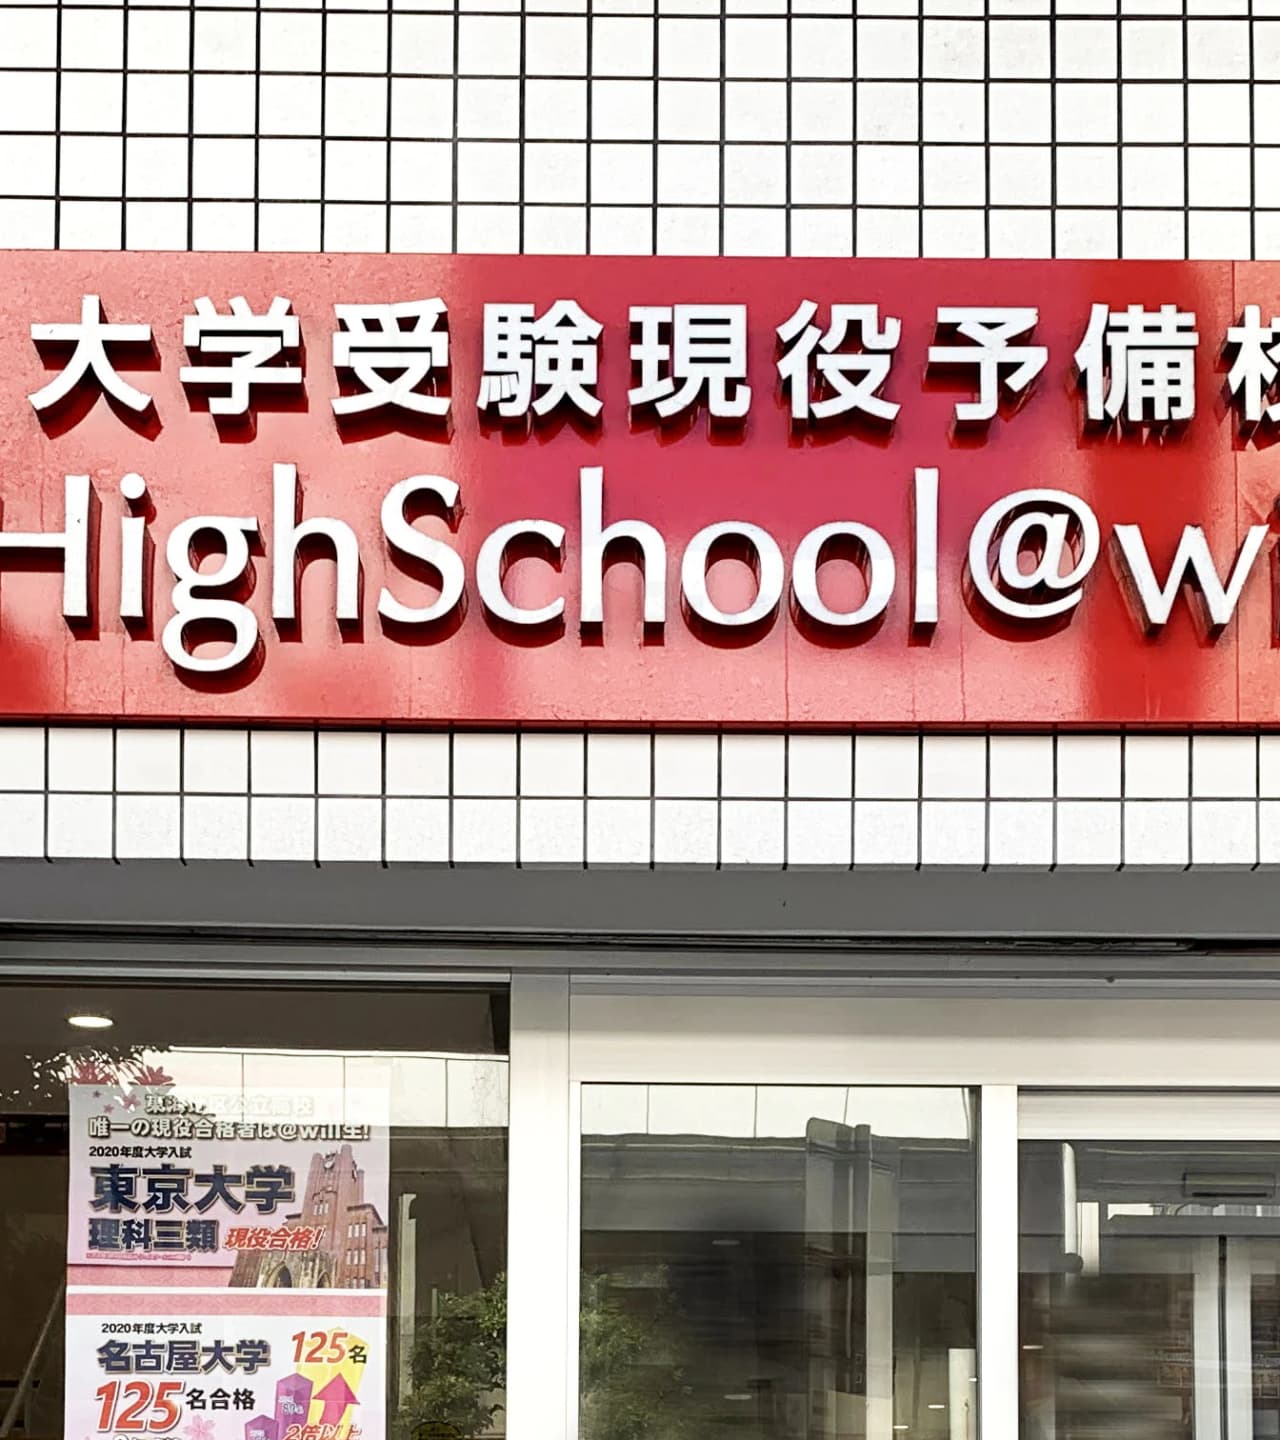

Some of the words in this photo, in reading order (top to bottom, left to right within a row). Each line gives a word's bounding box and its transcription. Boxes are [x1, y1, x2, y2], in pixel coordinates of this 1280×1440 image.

[88, 1162, 296, 1214] 東京大学
[87, 1218, 221, 1252] 理科三類
[224, 1226, 325, 1251] 現役合格!
[101, 1322, 203, 1335] 2020年度大学入試
[96, 1339, 271, 1375] 名古屋大学
[291, 1330, 368, 1365] 125名
